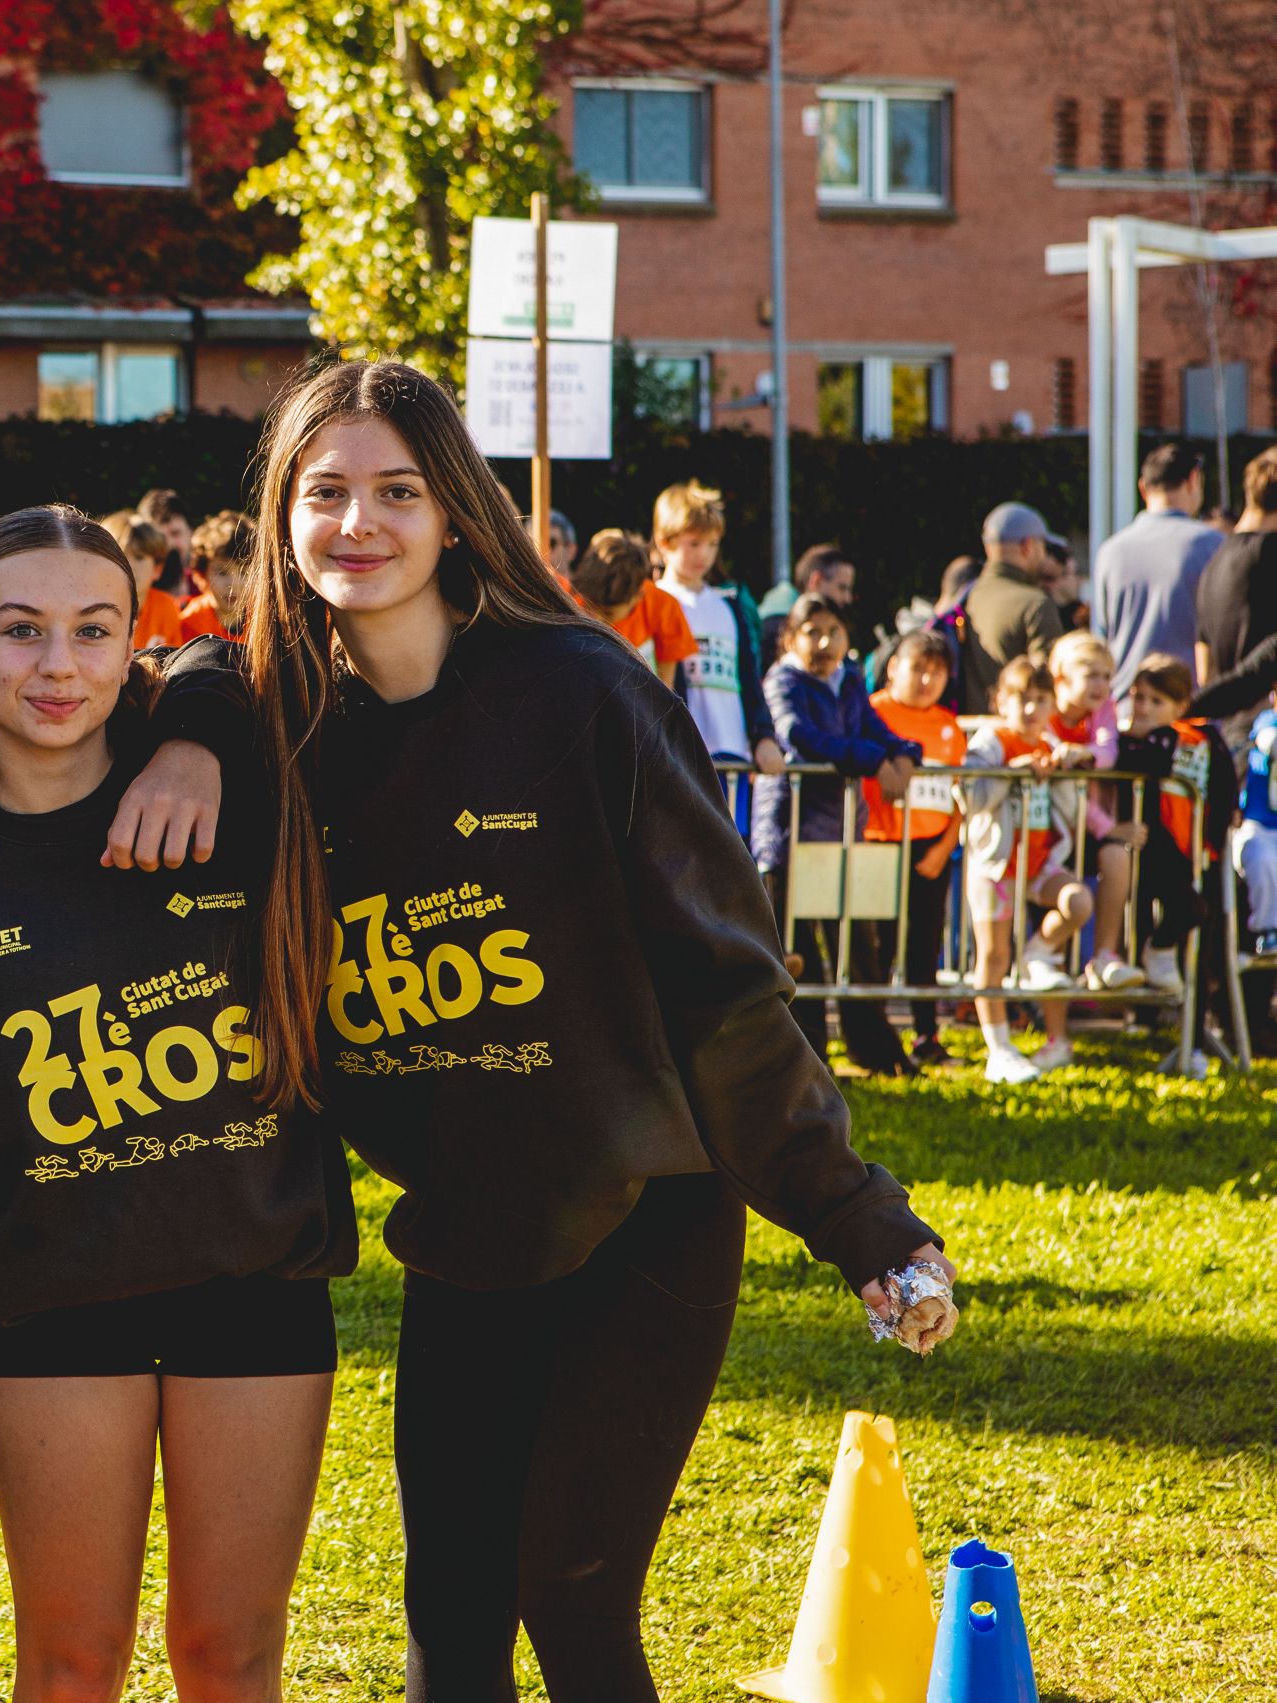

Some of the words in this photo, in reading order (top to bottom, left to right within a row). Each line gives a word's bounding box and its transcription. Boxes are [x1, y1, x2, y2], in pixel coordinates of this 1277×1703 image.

[481, 813, 526, 821] AJUNTAMENT
[482, 819, 538, 831] SantCugat
[196, 893, 235, 902] AJUNTAMENT
[236, 891, 245, 899] DE
[197, 898, 247, 910] SantCugat
[404, 888, 457, 915] Ciutat
[459, 882, 482, 900] de
[408, 907, 449, 932] Sant
[450, 894, 506, 918] Cugat
[121, 970, 180, 1002] Ciutat
[182, 961, 207, 980] de
[127, 990, 174, 1019] Sant
[174, 971, 230, 1001] Cugat
[328, 929, 544, 1044] CROS
[0, 983, 132, 1087] 27è
[28, 1005, 267, 1145] CROS
